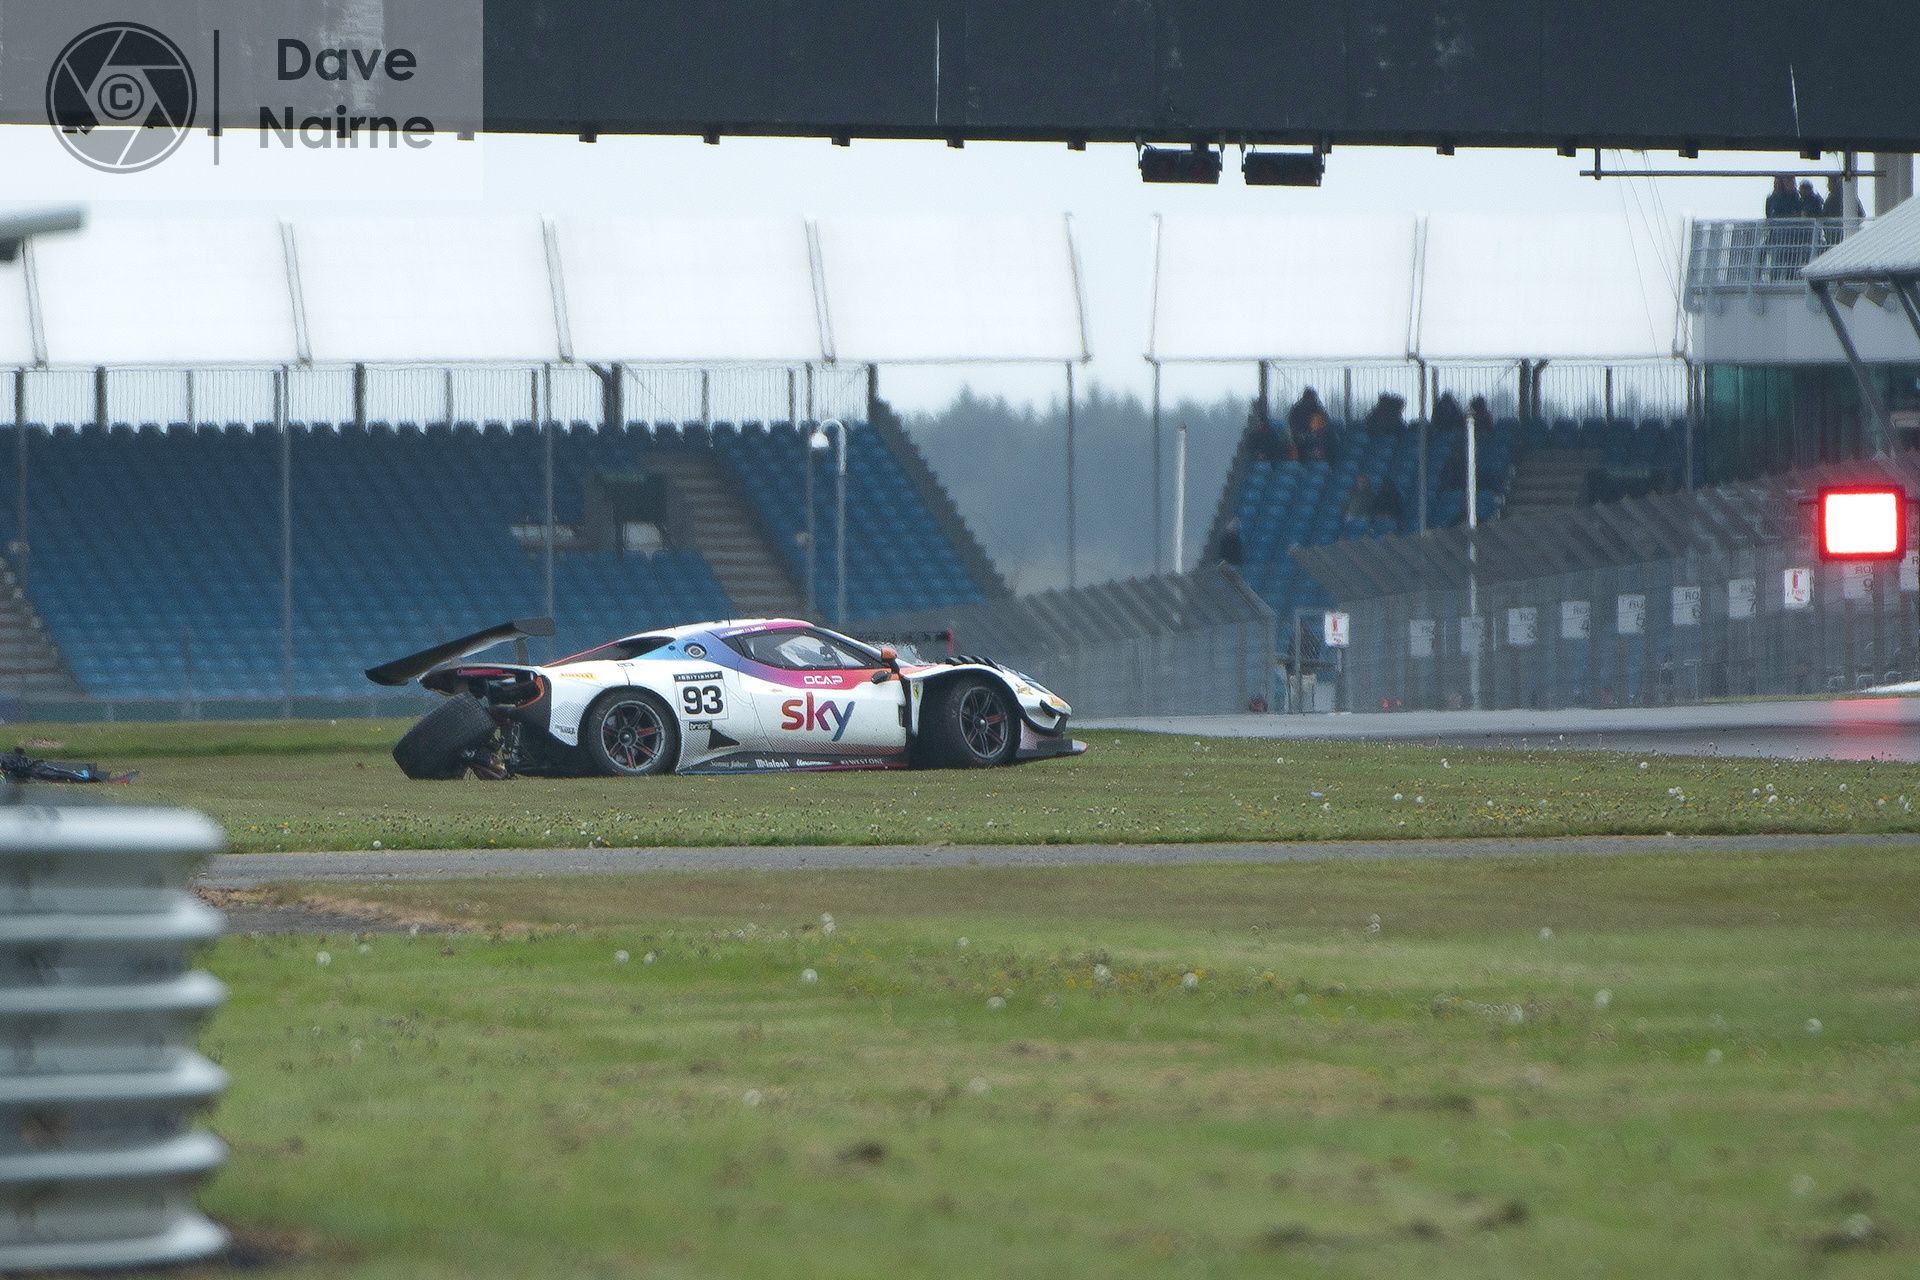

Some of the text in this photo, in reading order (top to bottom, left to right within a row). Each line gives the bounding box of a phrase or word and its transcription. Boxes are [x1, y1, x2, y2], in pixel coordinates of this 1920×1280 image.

[803, 675, 843, 685] OCAP
[683, 685, 724, 714] 93
[781, 691, 856, 742] sky
